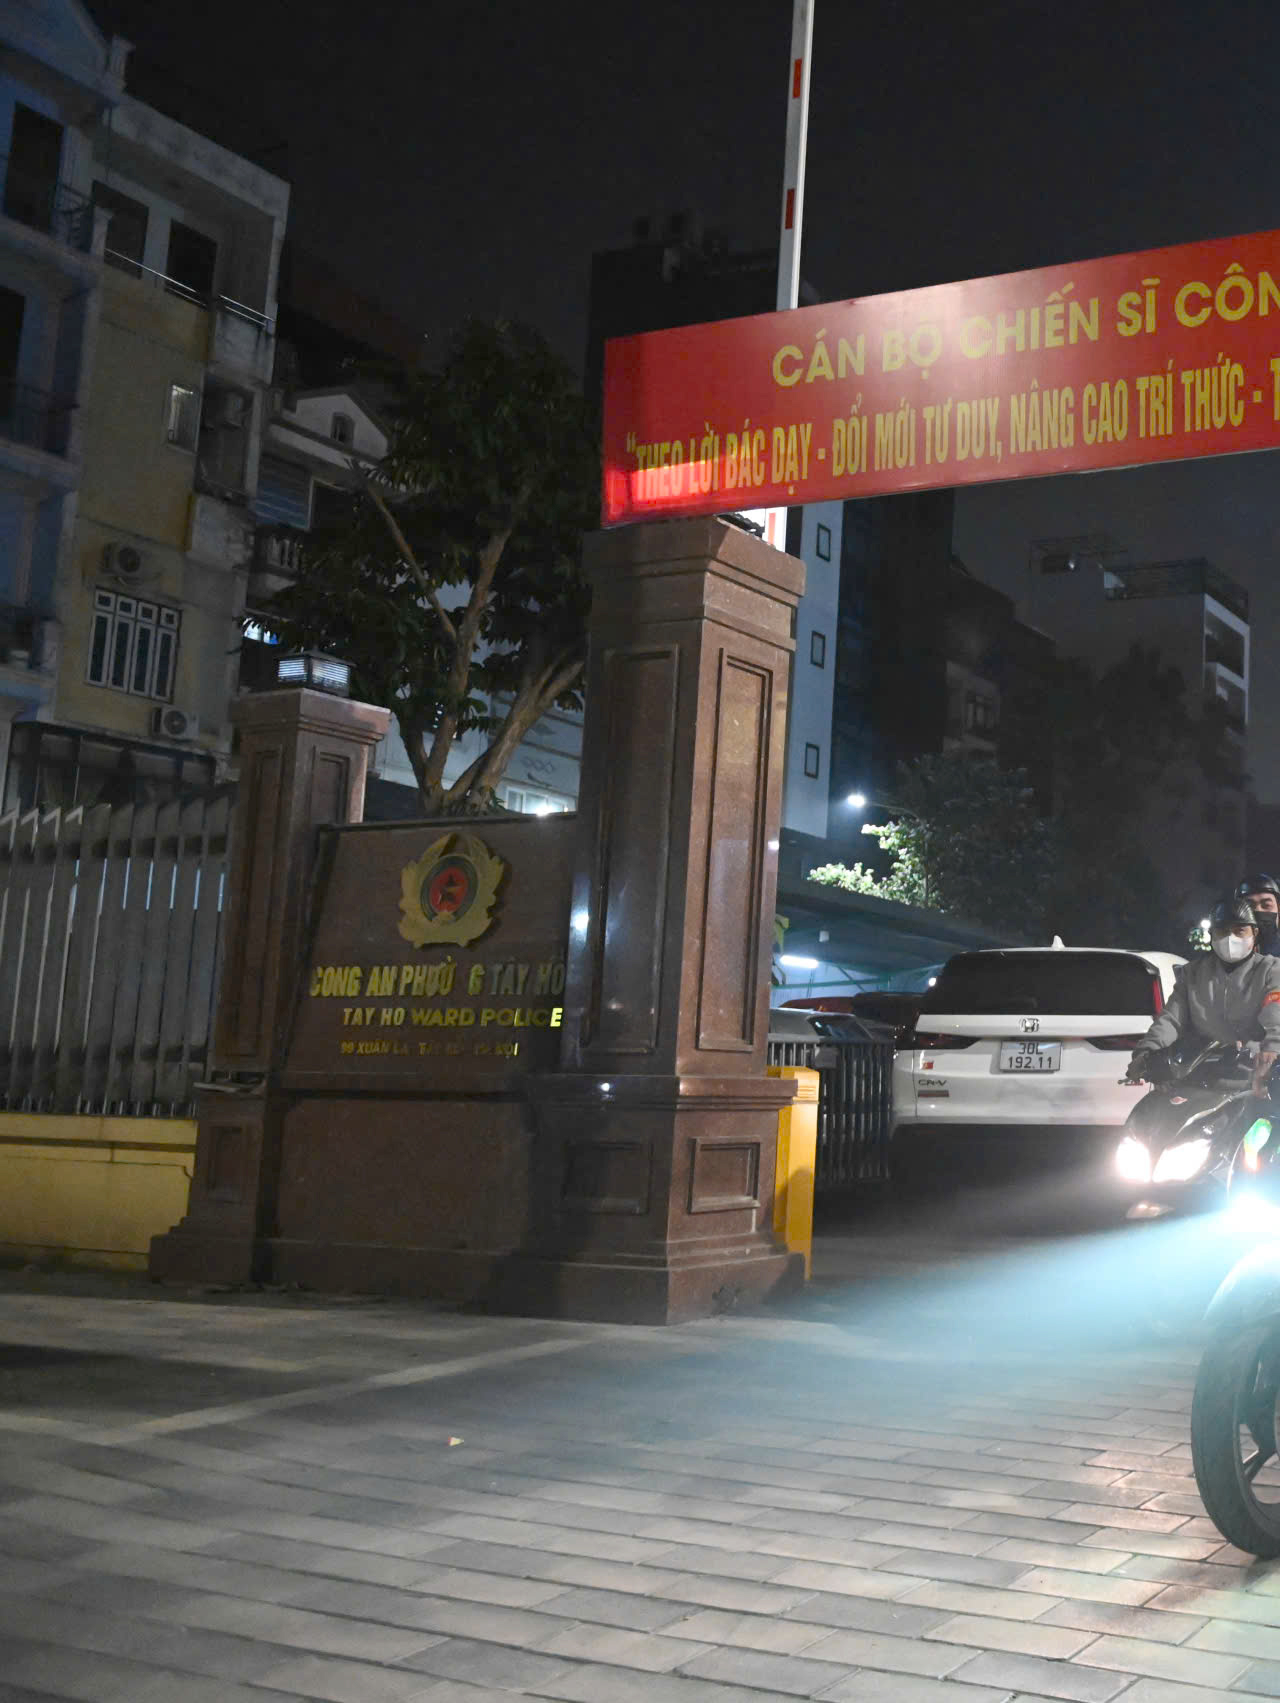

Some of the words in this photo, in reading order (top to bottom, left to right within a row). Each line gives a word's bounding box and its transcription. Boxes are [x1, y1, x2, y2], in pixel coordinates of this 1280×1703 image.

[772, 327, 866, 387] CÁN
[881, 315, 943, 380] BỘ
[959, 281, 1100, 360] CHIẾN
[1116, 277, 1161, 337] SĨ
[688, 420, 721, 494] LỜI
[724, 417, 766, 489] BÁC
[771, 422, 813, 496] DẠY
[831, 391, 868, 477] ĐỔI
[874, 398, 917, 471] MỚI
[922, 397, 952, 465] TƯ
[956, 395, 1003, 464] DUY,
[1009, 377, 1075, 454] NÂNG
[1082, 378, 1129, 446] CAO
[1135, 358, 1174, 438] TRÍ
[1180, 351, 1245, 433] THỨC
[365, 965, 398, 998] AN
[410, 1007, 476, 1027] WARD
[480, 1007, 564, 1027] POLICE
[1008, 1056, 1053, 1069] 192.11
[918, 1079, 947, 1087] CR-V
